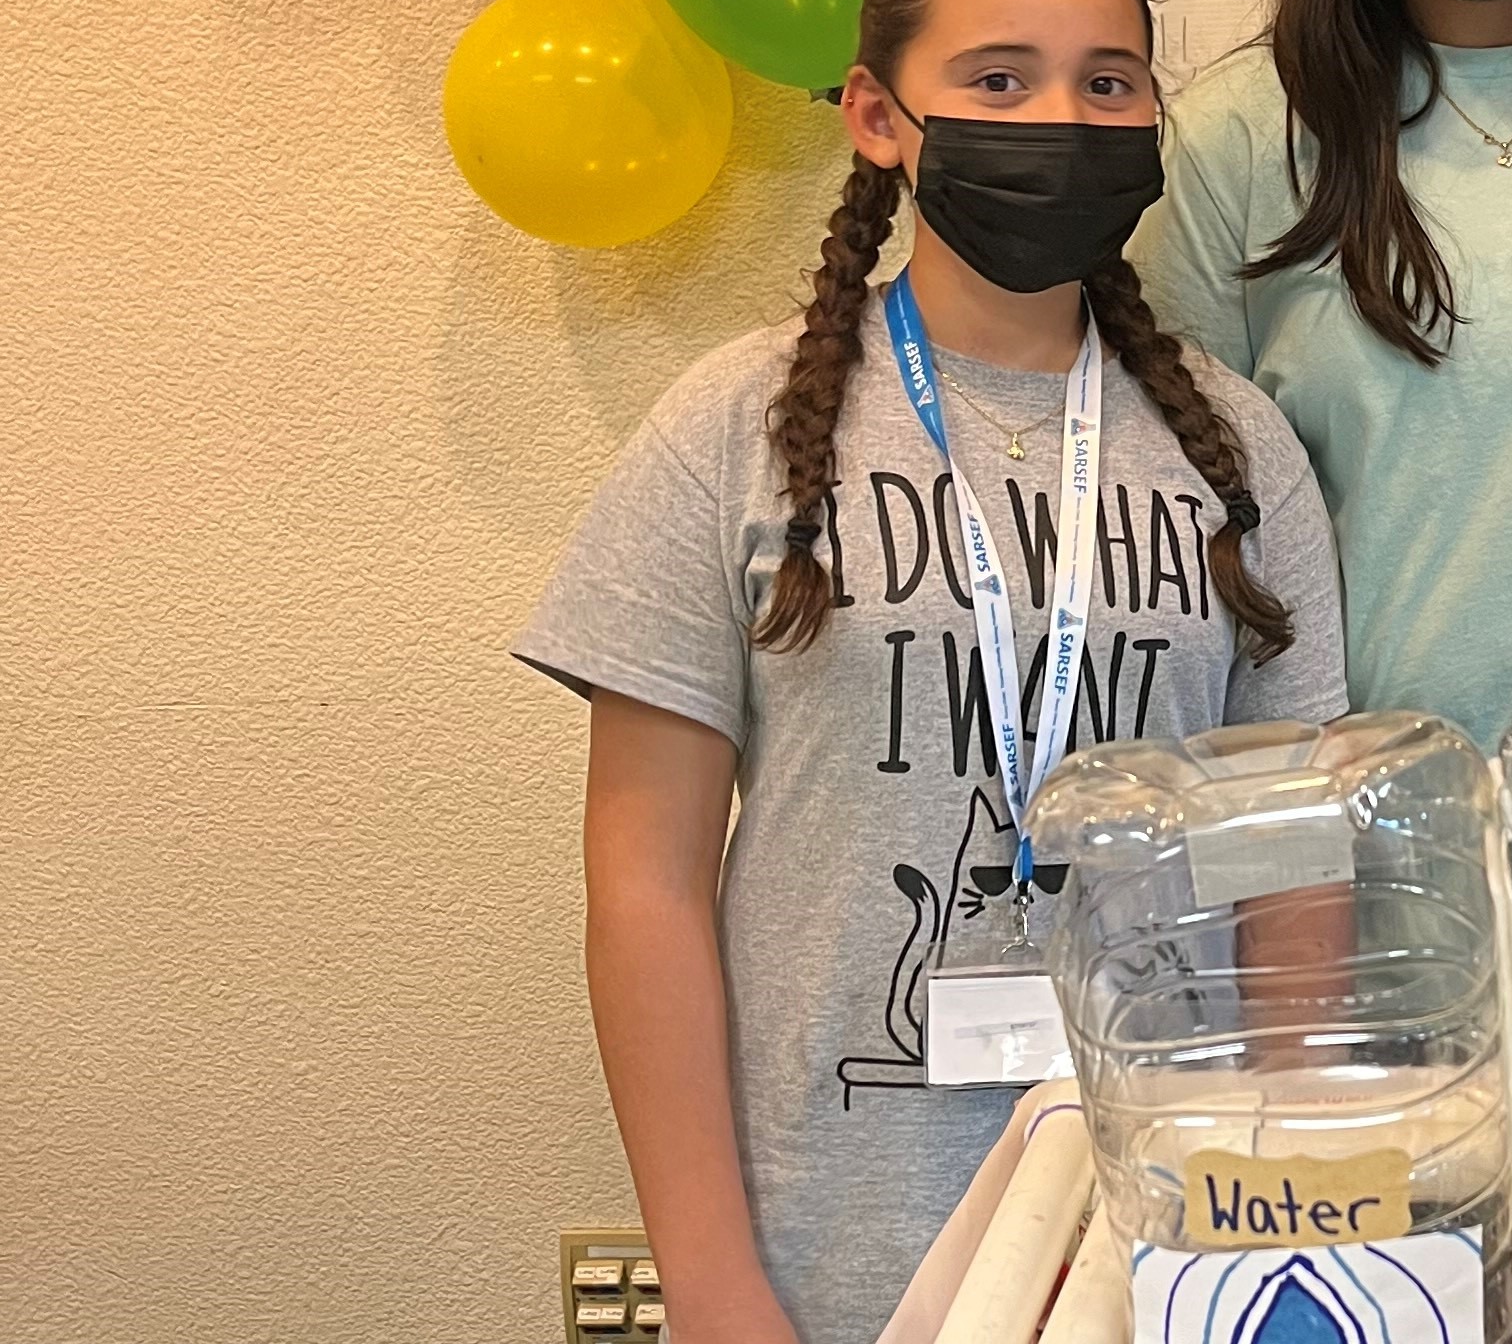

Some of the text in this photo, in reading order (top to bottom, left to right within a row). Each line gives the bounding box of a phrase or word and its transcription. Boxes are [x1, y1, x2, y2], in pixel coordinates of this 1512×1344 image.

[903, 341, 928, 390] SARSEF
[1073, 438, 1089, 494] SARSEF
[966, 513, 991, 573] SARSEF
[1054, 632, 1074, 696] SARSEF
[876, 629, 916, 773] I
[1003, 723, 1019, 787] SARSEF
[1203, 1174, 1381, 1236] Water
